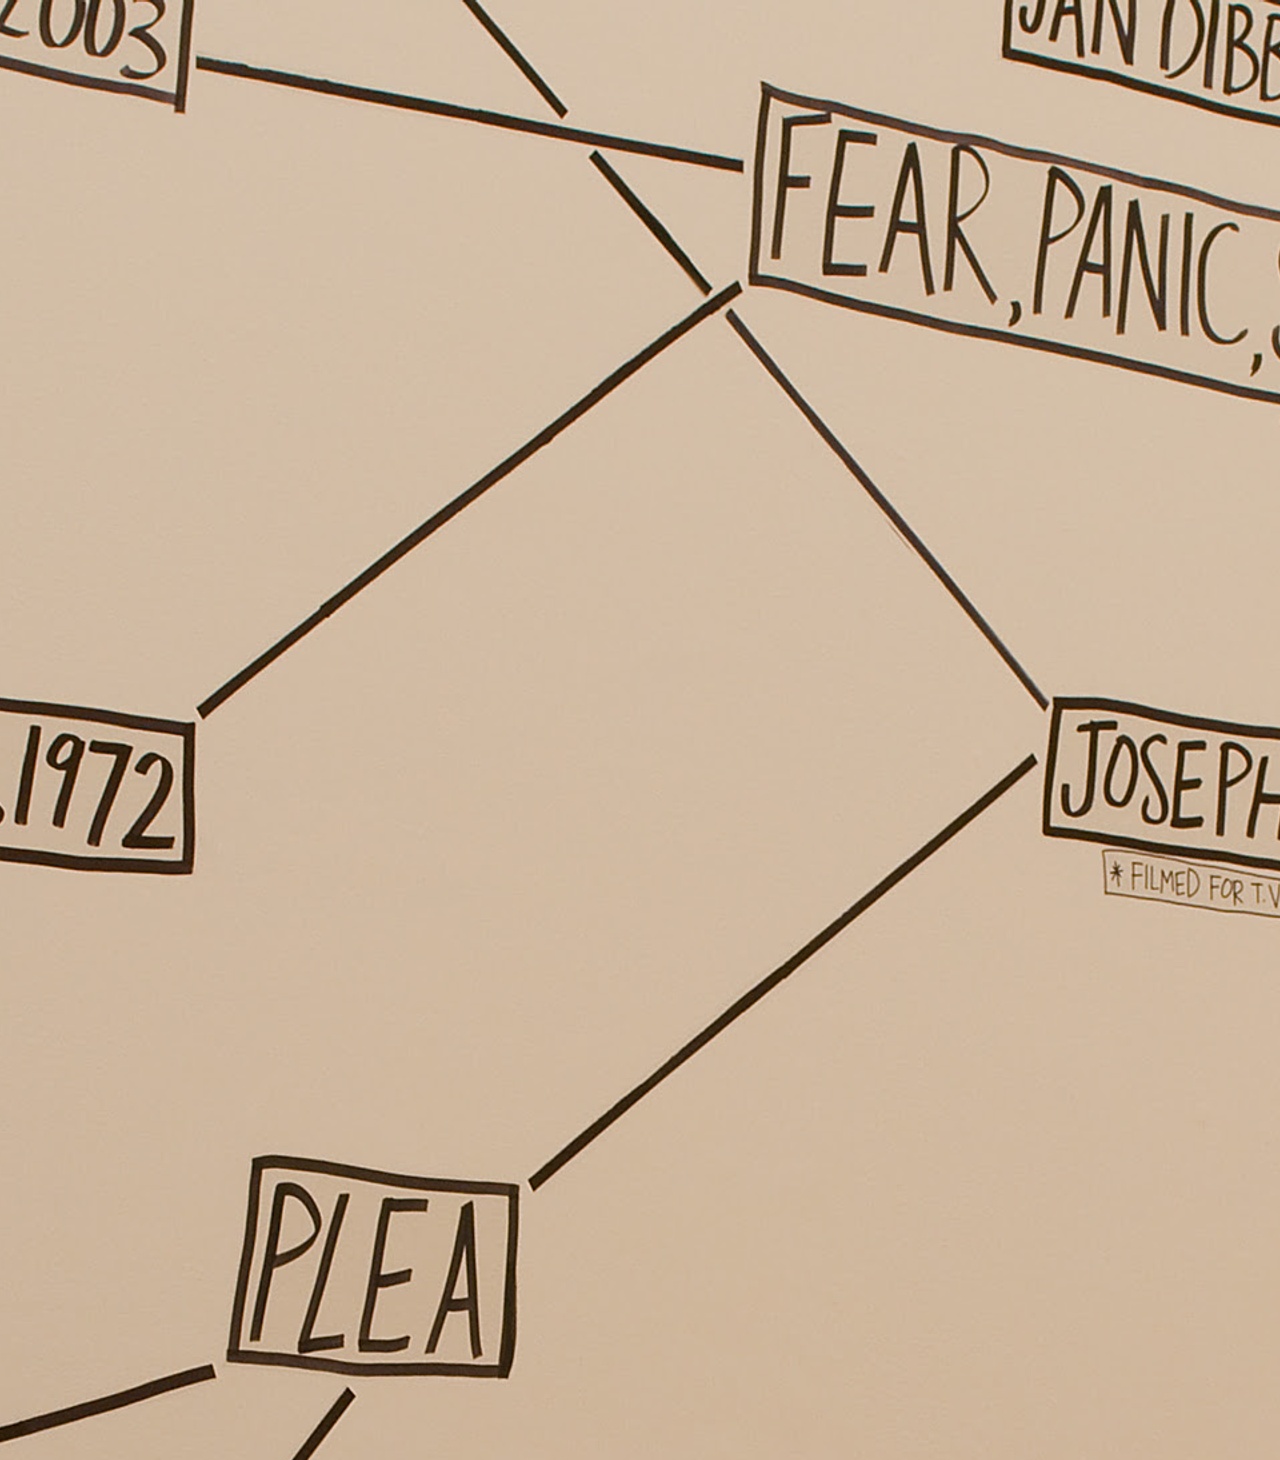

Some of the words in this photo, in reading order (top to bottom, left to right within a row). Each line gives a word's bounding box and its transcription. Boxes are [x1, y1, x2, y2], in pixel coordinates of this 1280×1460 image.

[1130, 861, 1201, 900] FILMED
[1209, 869, 1244, 906] FOR
[249, 1181, 483, 1359] PLEA
